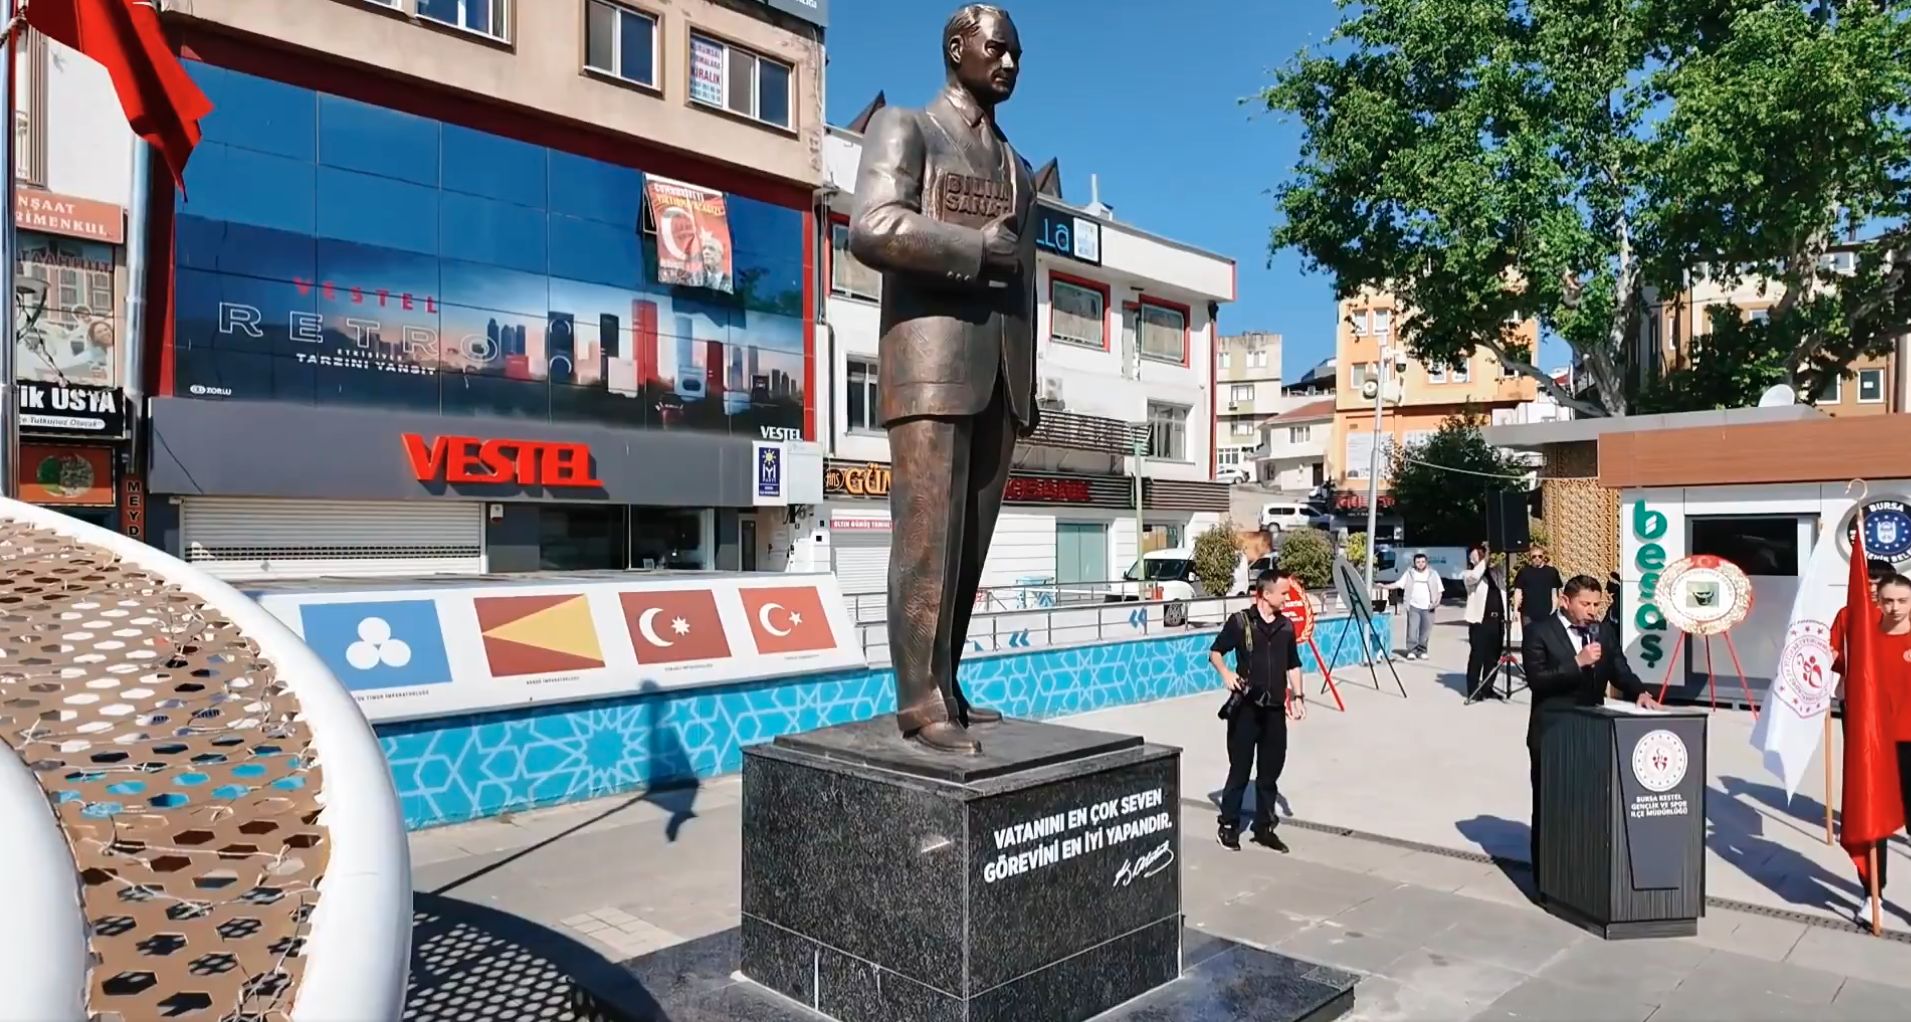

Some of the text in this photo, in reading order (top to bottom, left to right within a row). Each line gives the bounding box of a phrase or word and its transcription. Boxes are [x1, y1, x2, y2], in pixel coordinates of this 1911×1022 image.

[293, 277, 438, 314] VESTEL
[219, 301, 498, 362] RETRO
[51, 387, 116, 413] USTA
[760, 425, 803, 440] VESTEL
[401, 432, 605, 487] VESTEL
[1869, 502, 1904, 512] BURSA
[1634, 498, 1667, 669] besaş
[1636, 793, 1682, 803] BURSA KESTEL
[1670, 800, 1687, 808] SPOR
[994, 788, 1162, 849] VATANINI EN ÇOK SEVEN
[984, 812, 1172, 883] GÖREVİNİ EN İYİ YAPANDIR.
